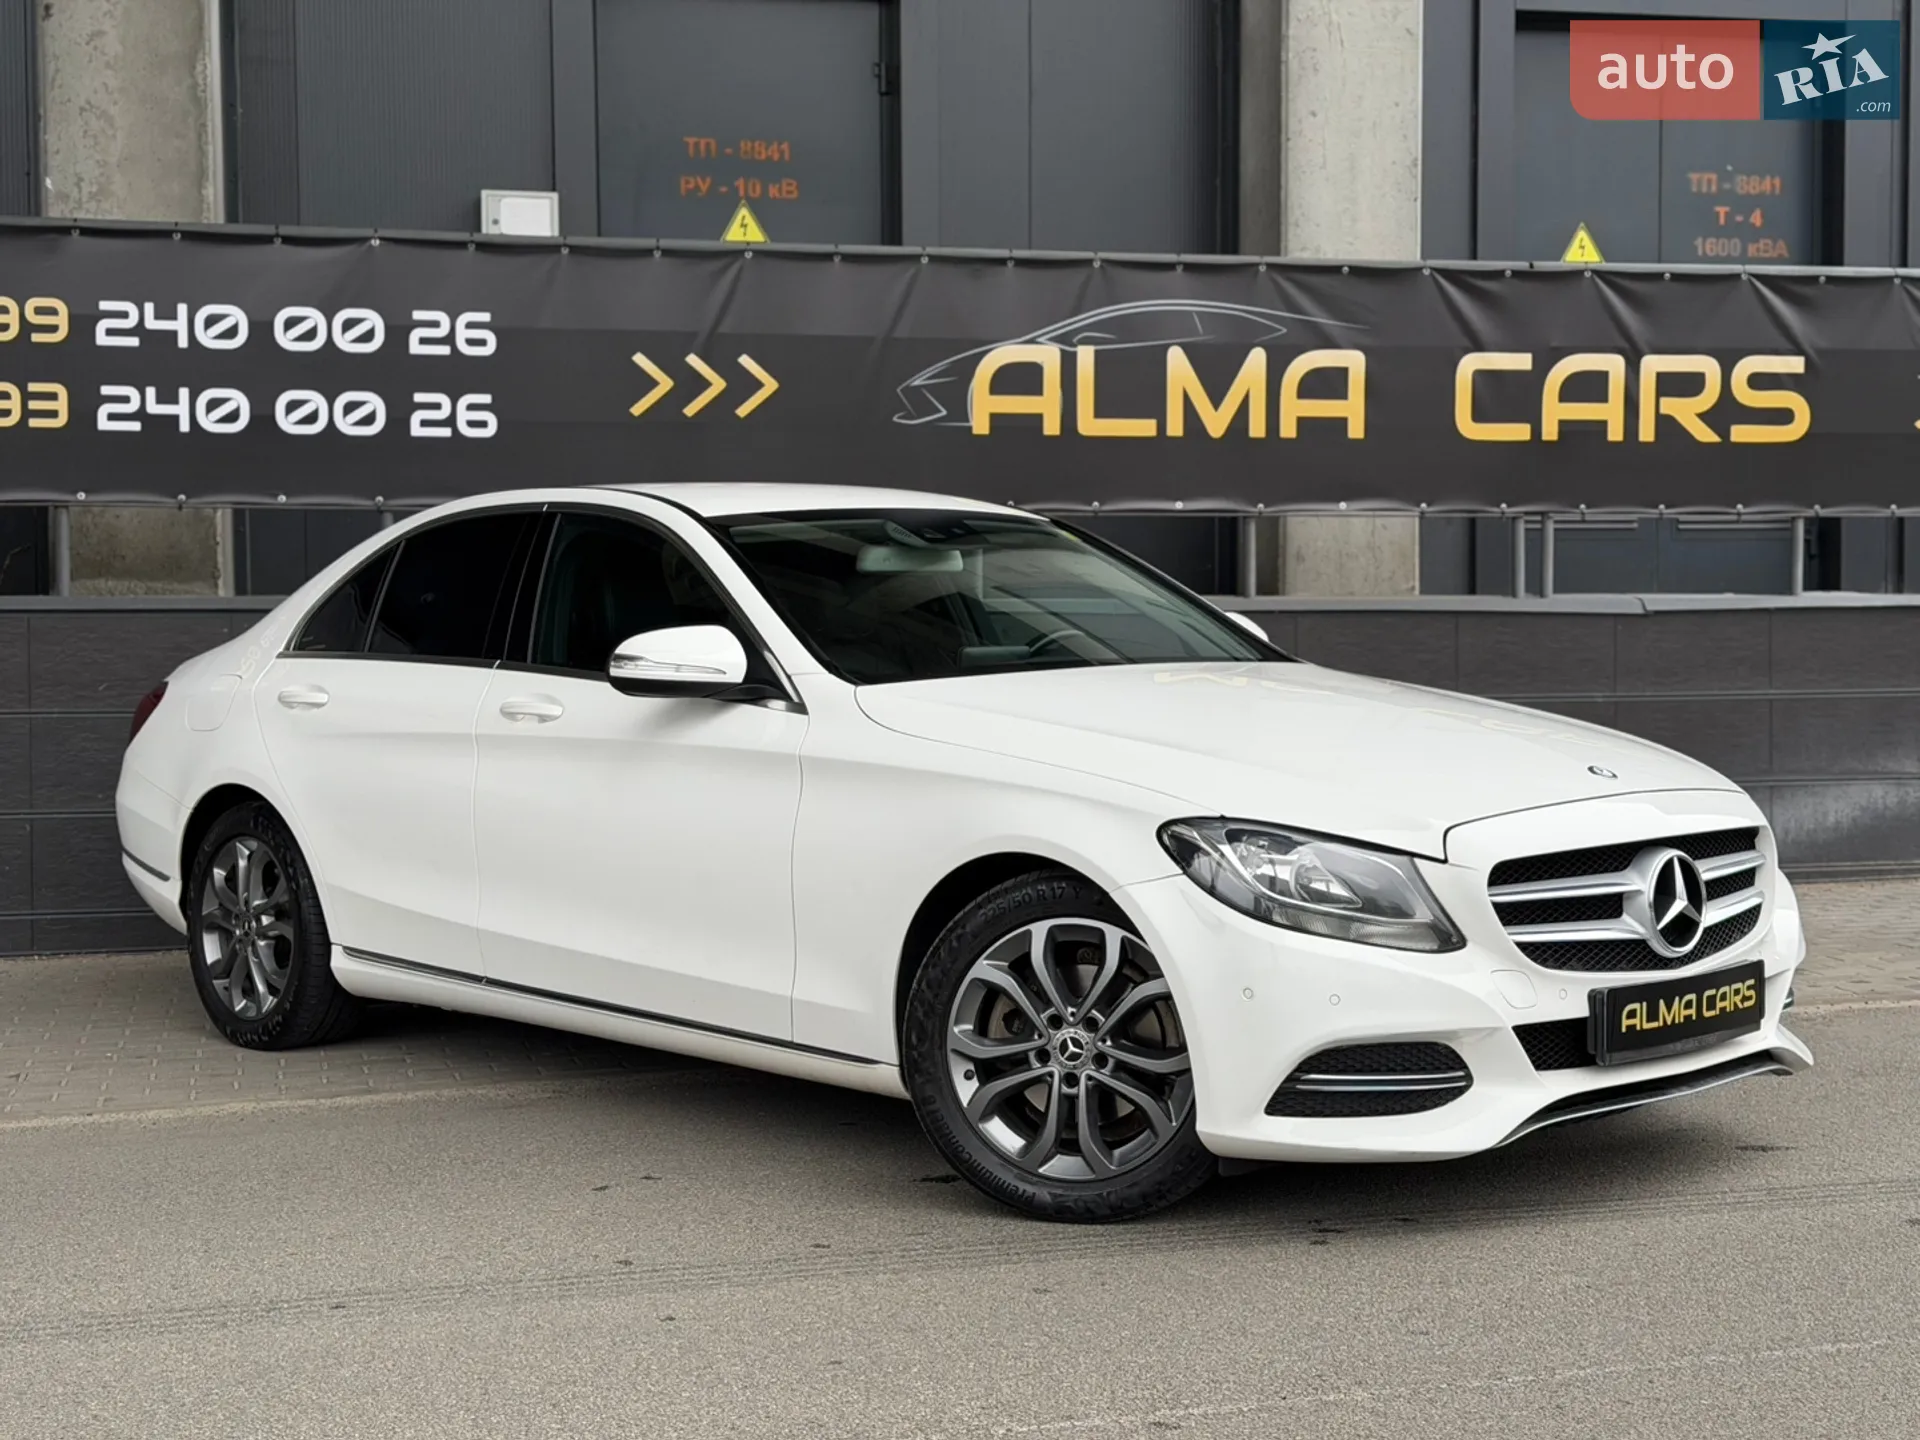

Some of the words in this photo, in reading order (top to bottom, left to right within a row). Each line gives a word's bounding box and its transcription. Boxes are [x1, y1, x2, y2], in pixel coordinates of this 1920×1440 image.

[682, 136, 717, 159] ТП
[739, 138, 791, 162] 8841
[679, 174, 712, 197] РУ
[734, 176, 763, 198] 10
[768, 178, 799, 200] кВ
[1748, 207, 1765, 228] 4
[1693, 236, 1742, 257] 1600
[95, 300, 249, 350] 240
[273, 306, 386, 354] 00
[408, 310, 498, 357] 26
[96, 385, 251, 434] 240
[274, 389, 387, 436] 00
[409, 392, 499, 438] 26
[971, 346, 1368, 440] ALMA
[1454, 352, 1812, 445] CARS
[1621, 993, 1697, 1033] ALMA
[1702, 979, 1757, 1018] CARS
